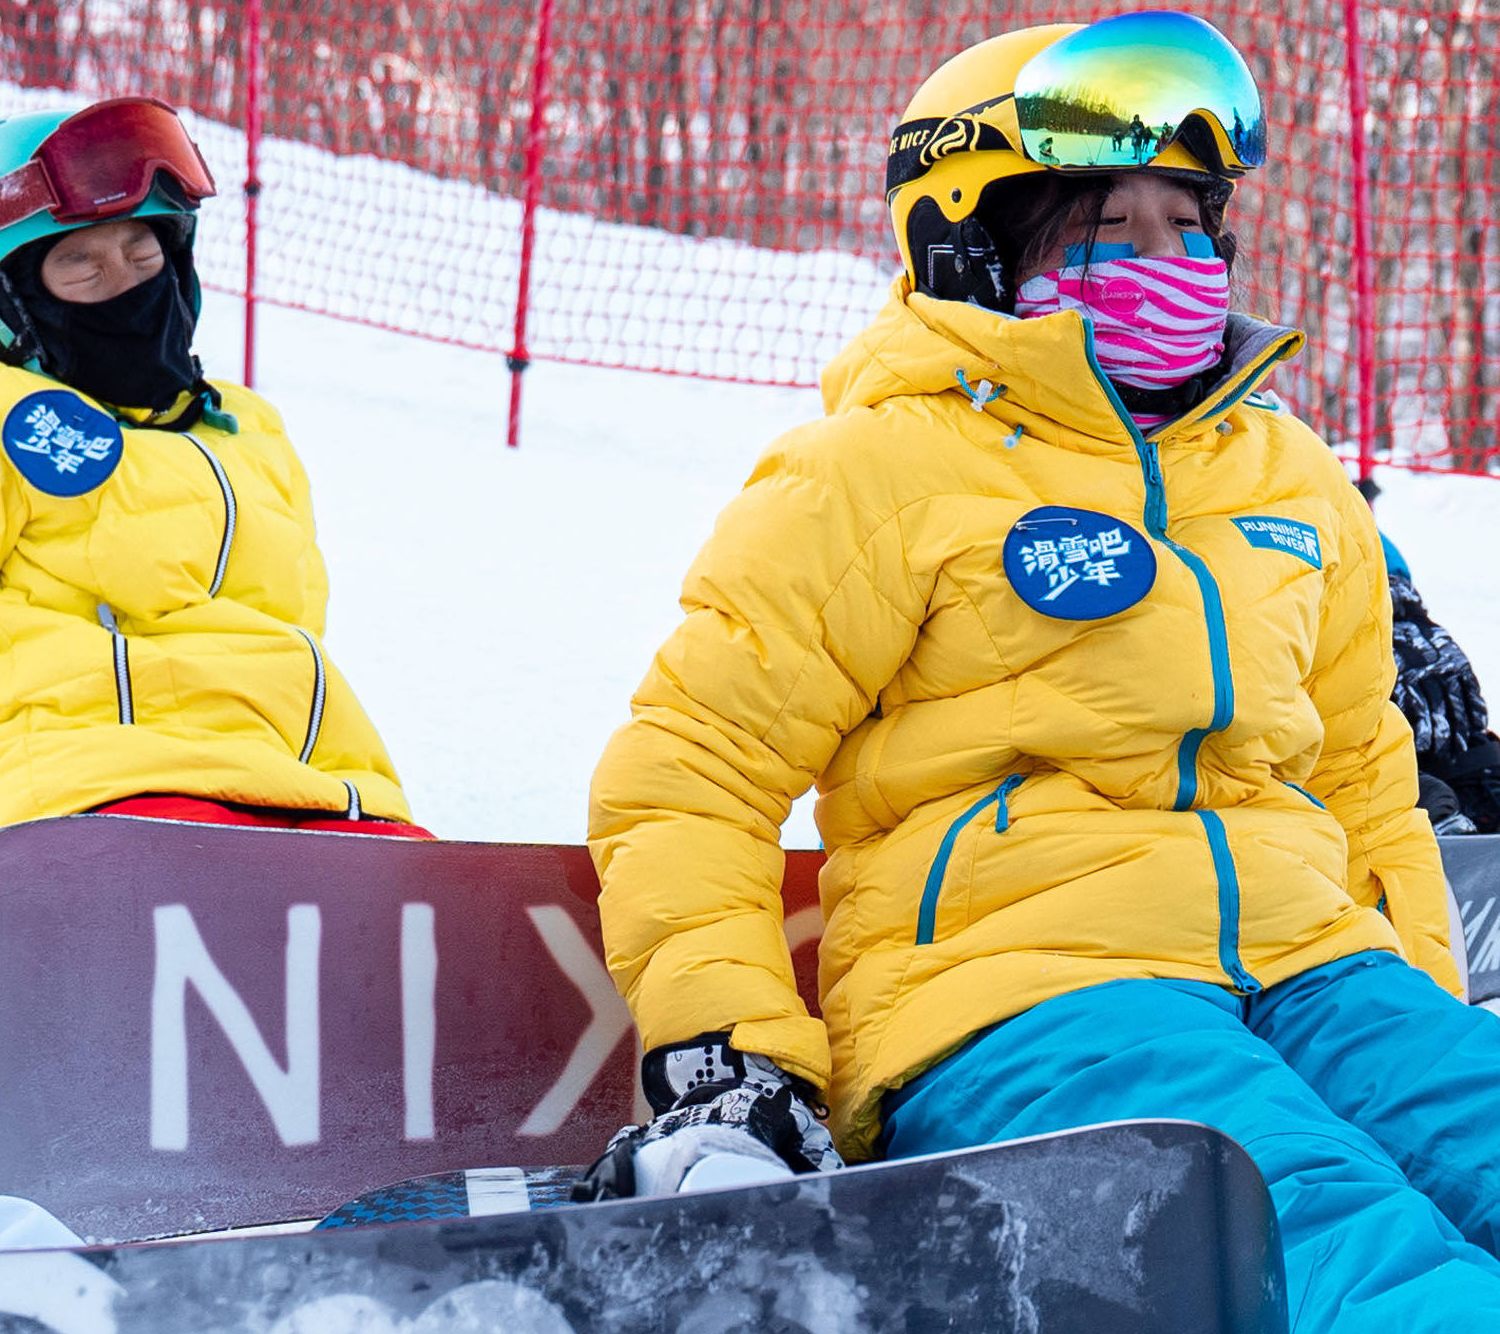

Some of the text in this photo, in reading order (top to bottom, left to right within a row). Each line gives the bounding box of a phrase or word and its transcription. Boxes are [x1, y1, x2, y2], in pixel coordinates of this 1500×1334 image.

[24, 404, 116, 461] 滑雪吧
[12, 435, 85, 474] 少年
[1241, 521, 1303, 540] RUNNING
[1270, 532, 1308, 554] RIVER
[1019, 527, 1131, 577] 滑雪吧
[1038, 558, 1123, 601] 少年
